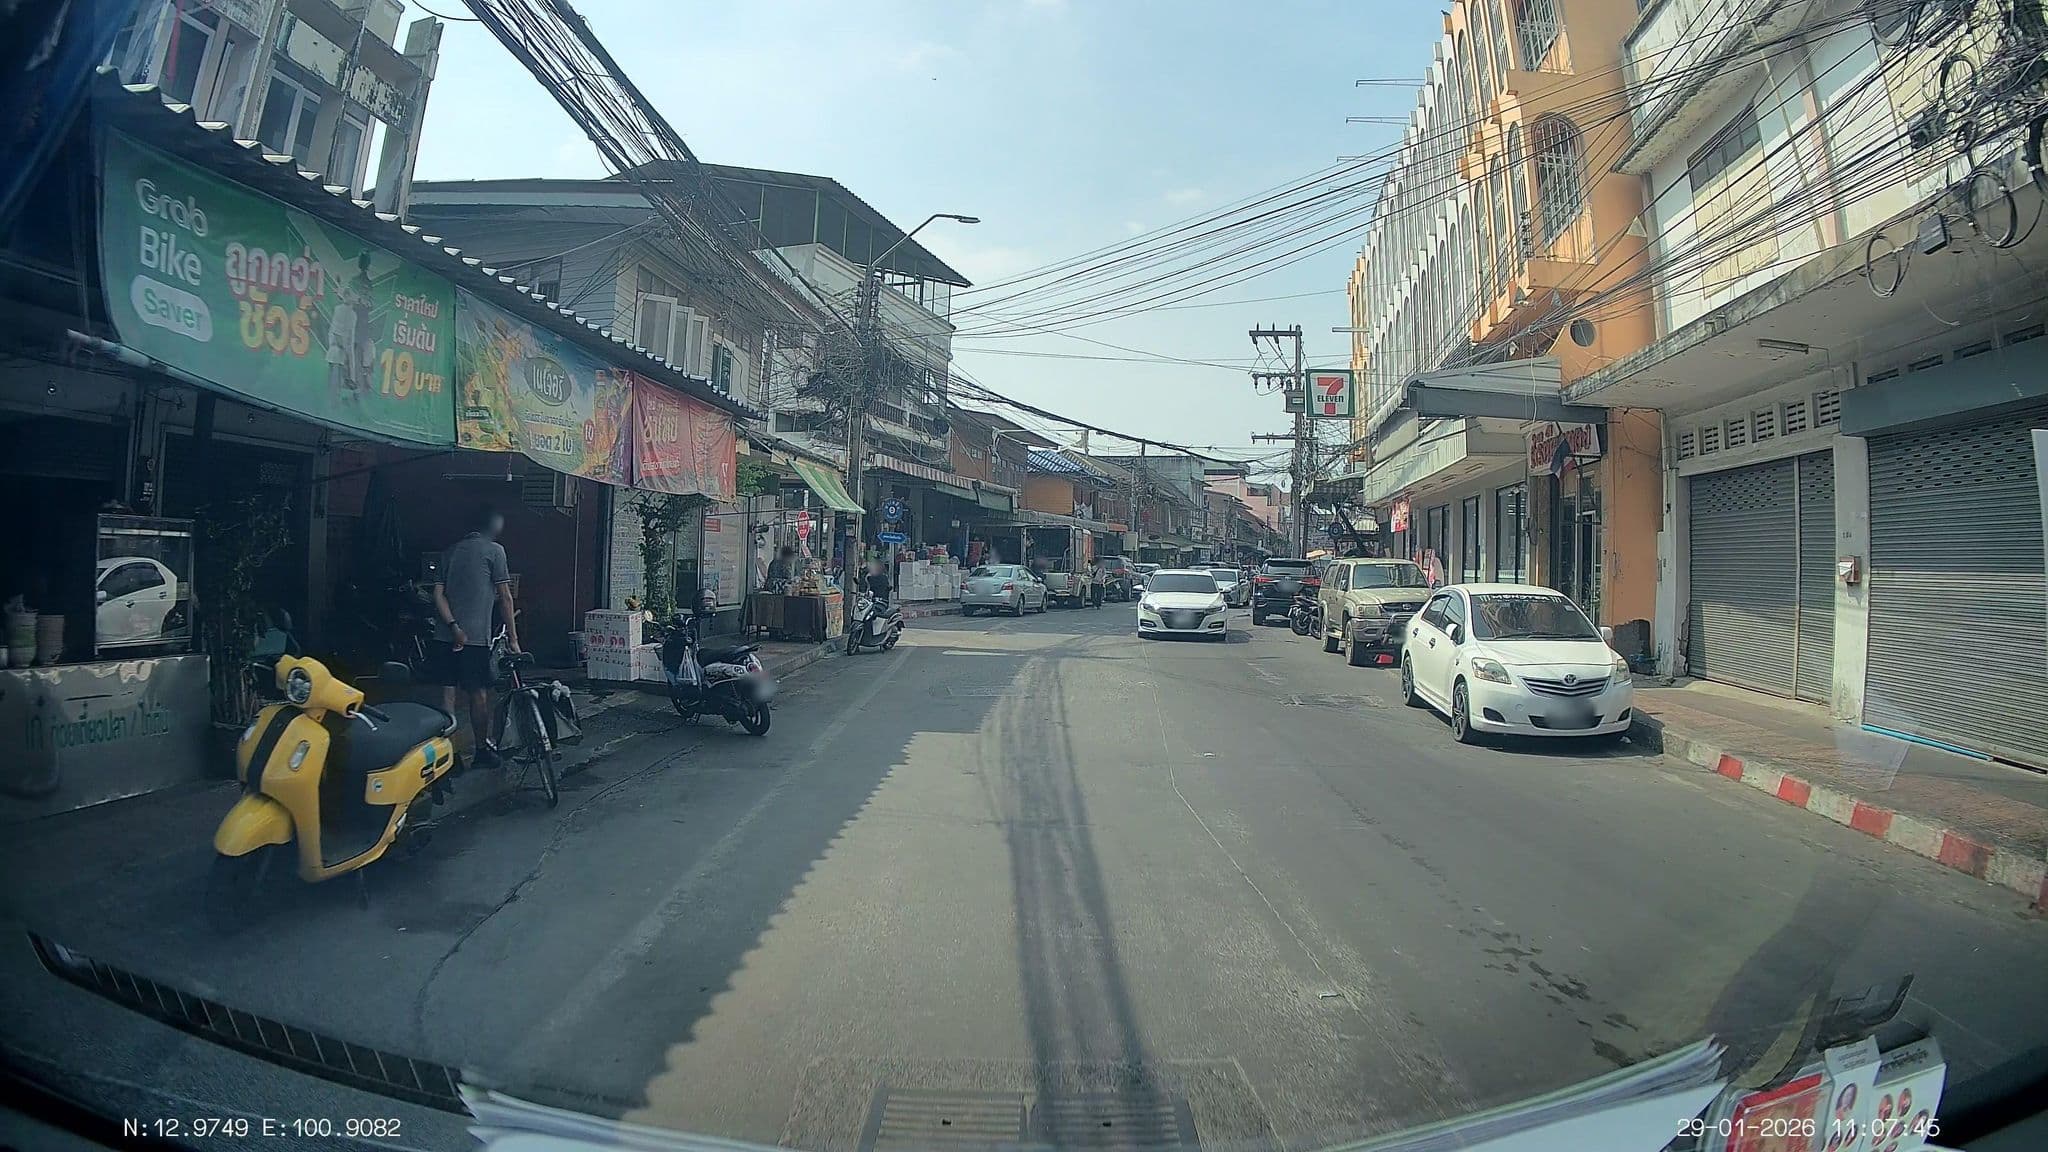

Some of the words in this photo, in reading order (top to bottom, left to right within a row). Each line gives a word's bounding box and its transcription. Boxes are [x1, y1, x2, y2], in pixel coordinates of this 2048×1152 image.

[135, 178, 209, 237] Grab
[140, 226, 201, 286] Bike
[225, 242, 325, 300] ลูกกว่า
[239, 285, 312, 357] ชัวร์
[393, 312, 436, 352] เริ่มต้น
[395, 293, 439, 319] ราคาใหม่
[380, 348, 414, 397] 19
[415, 371, 446, 393] บาท
[1317, 394, 1344, 403] ELEVEN
